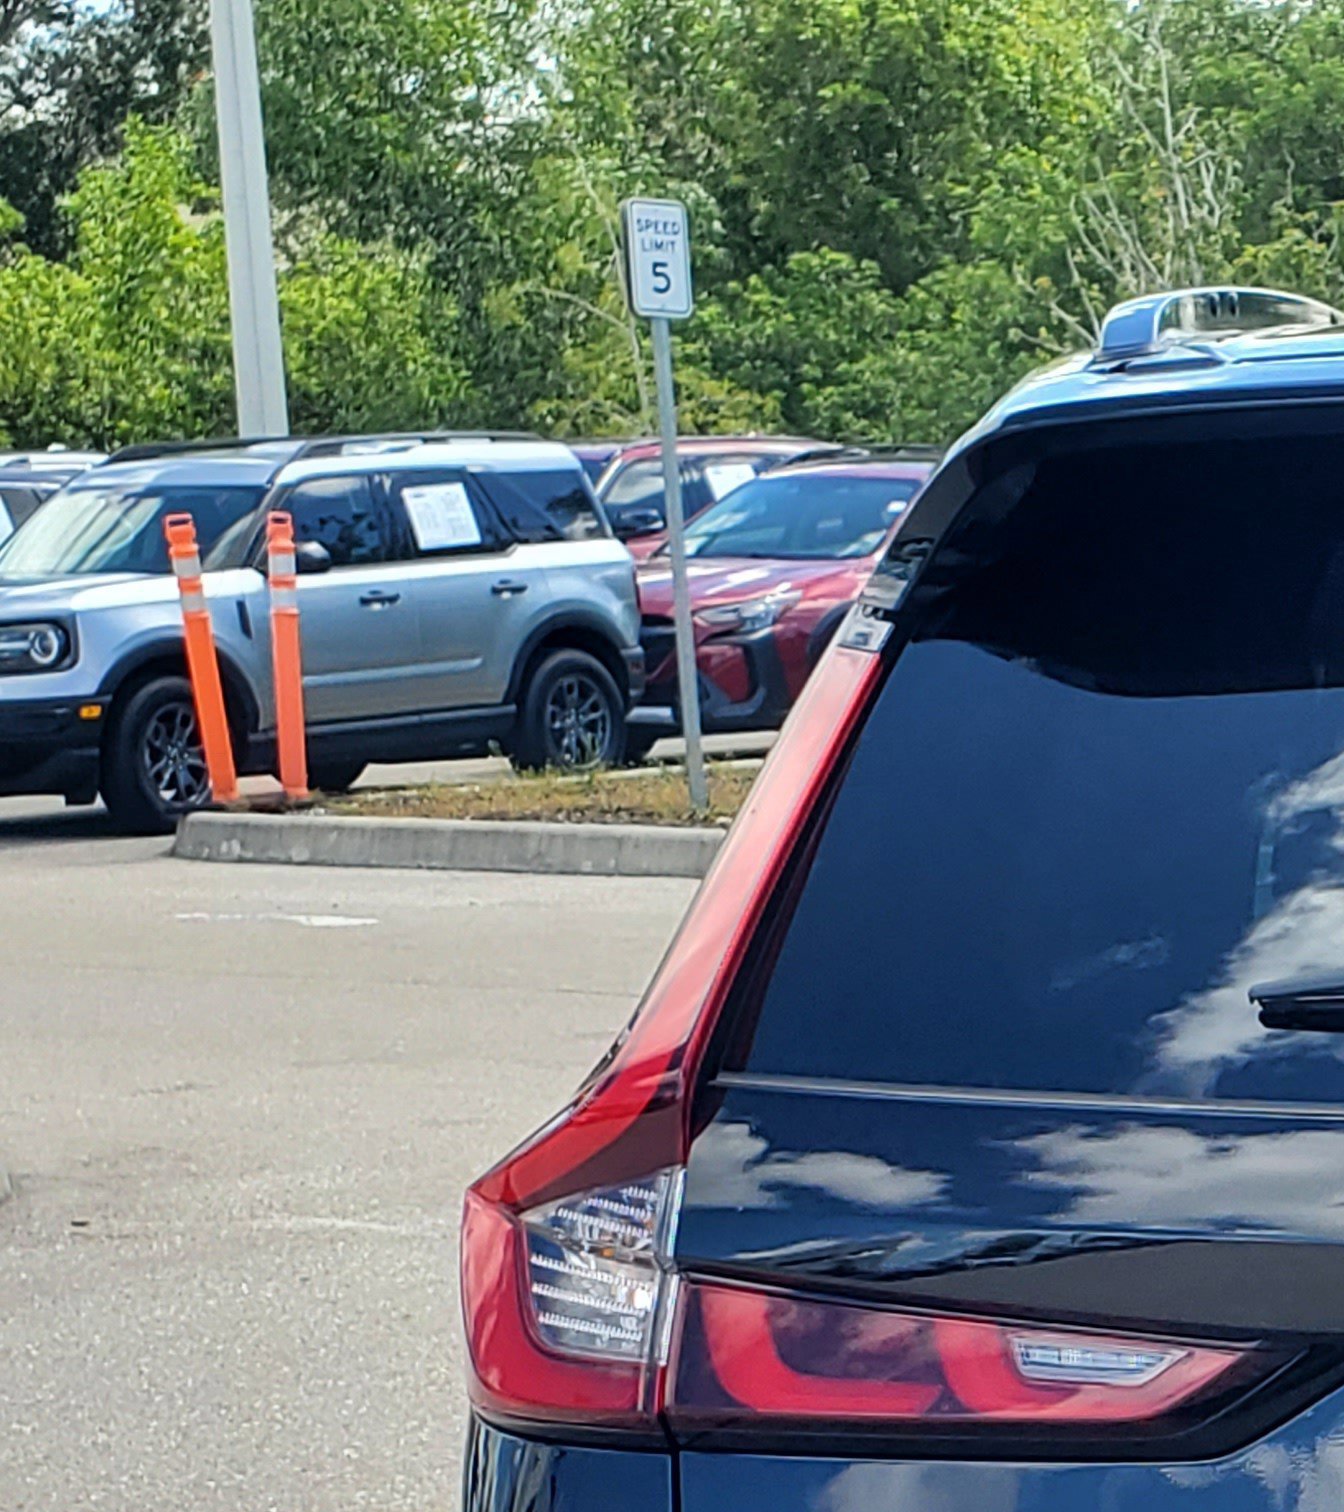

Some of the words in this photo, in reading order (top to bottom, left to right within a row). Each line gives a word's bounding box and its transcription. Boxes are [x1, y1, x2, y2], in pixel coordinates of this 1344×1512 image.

[636, 218, 680, 236] SPEED
[641, 238, 676, 253] LIMIT
[651, 261, 671, 294] 5
